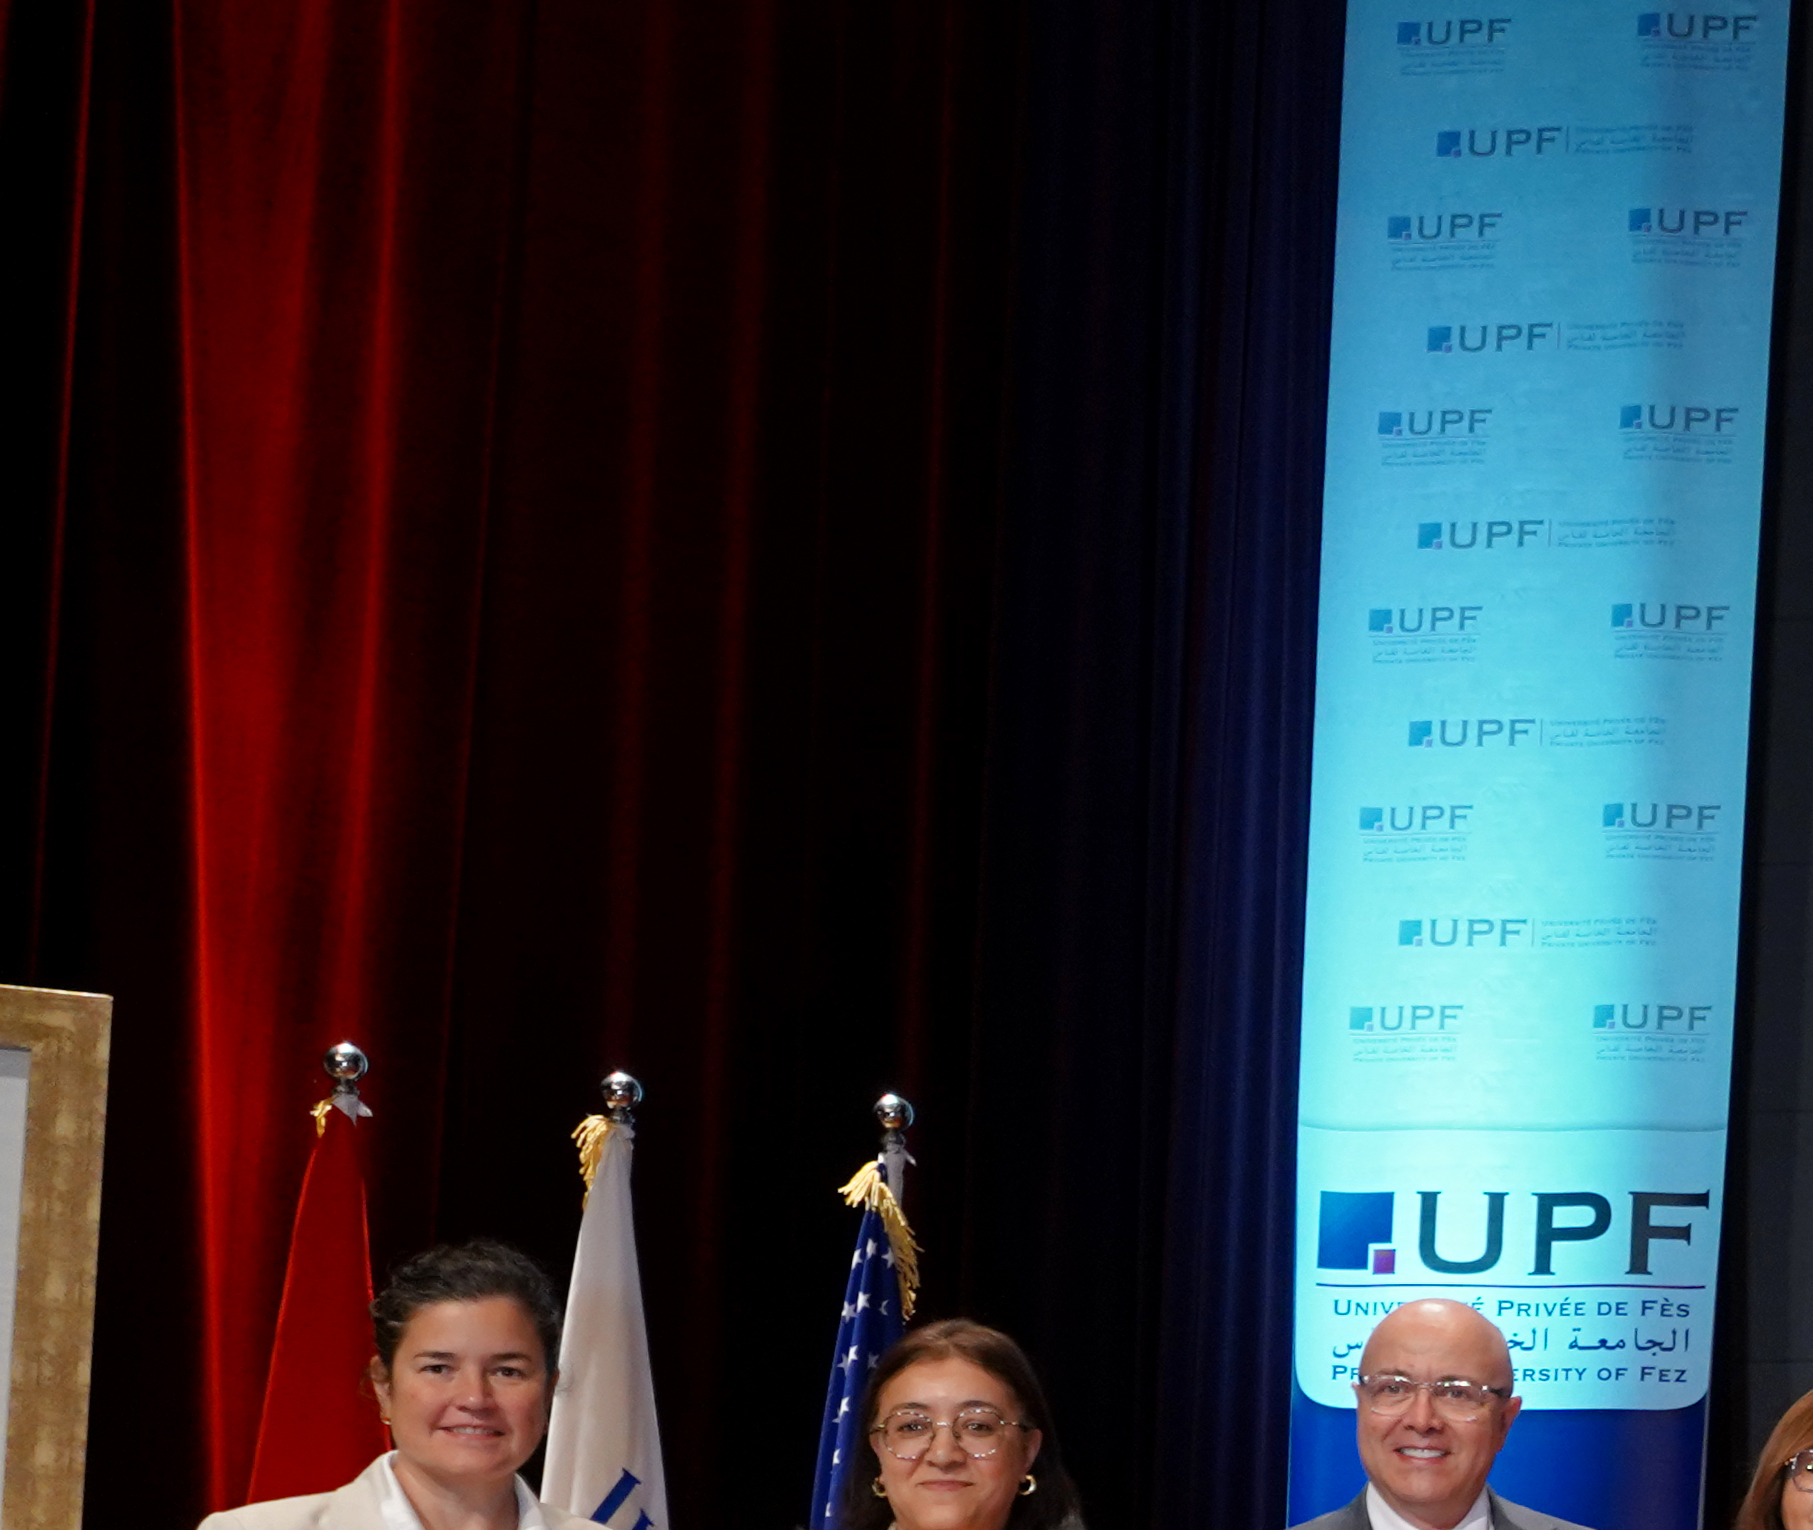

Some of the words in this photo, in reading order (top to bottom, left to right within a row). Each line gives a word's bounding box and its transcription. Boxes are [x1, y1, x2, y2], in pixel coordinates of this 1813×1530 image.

[1423, 18, 1511, 45] UPF
[1668, 13, 1757, 40] UPF
[1468, 127, 1562, 156] UPF
[1418, 213, 1502, 239] UPF
[1658, 208, 1747, 235] UPF
[1459, 323, 1553, 352] UPF
[1409, 409, 1492, 435] UPF
[1649, 405, 1739, 432] UPF
[1450, 520, 1544, 549] UPF
[1399, 606, 1483, 632] UPF
[1640, 603, 1730, 630] UPF
[1440, 719, 1535, 747] UPF
[1390, 805, 1473, 831] UPF
[1631, 803, 1721, 830] UPF
[1430, 919, 1527, 946] UPF
[1380, 1005, 1463, 1030] UPF
[1622, 1004, 1712, 1030] UPF
[1416, 1190, 1710, 1275] UPF
[1497, 1297, 1585, 1317] PRIVÉE
[1597, 1302, 1628, 1316] DE
[1641, 1298, 1690, 1318] FÈS
[1568, 1328, 1689, 1356] الجامعة
[1514, 1367, 1587, 1383] ERSITY
[1597, 1368, 1628, 1381] OF
[1640, 1366, 1686, 1383] FEZ
